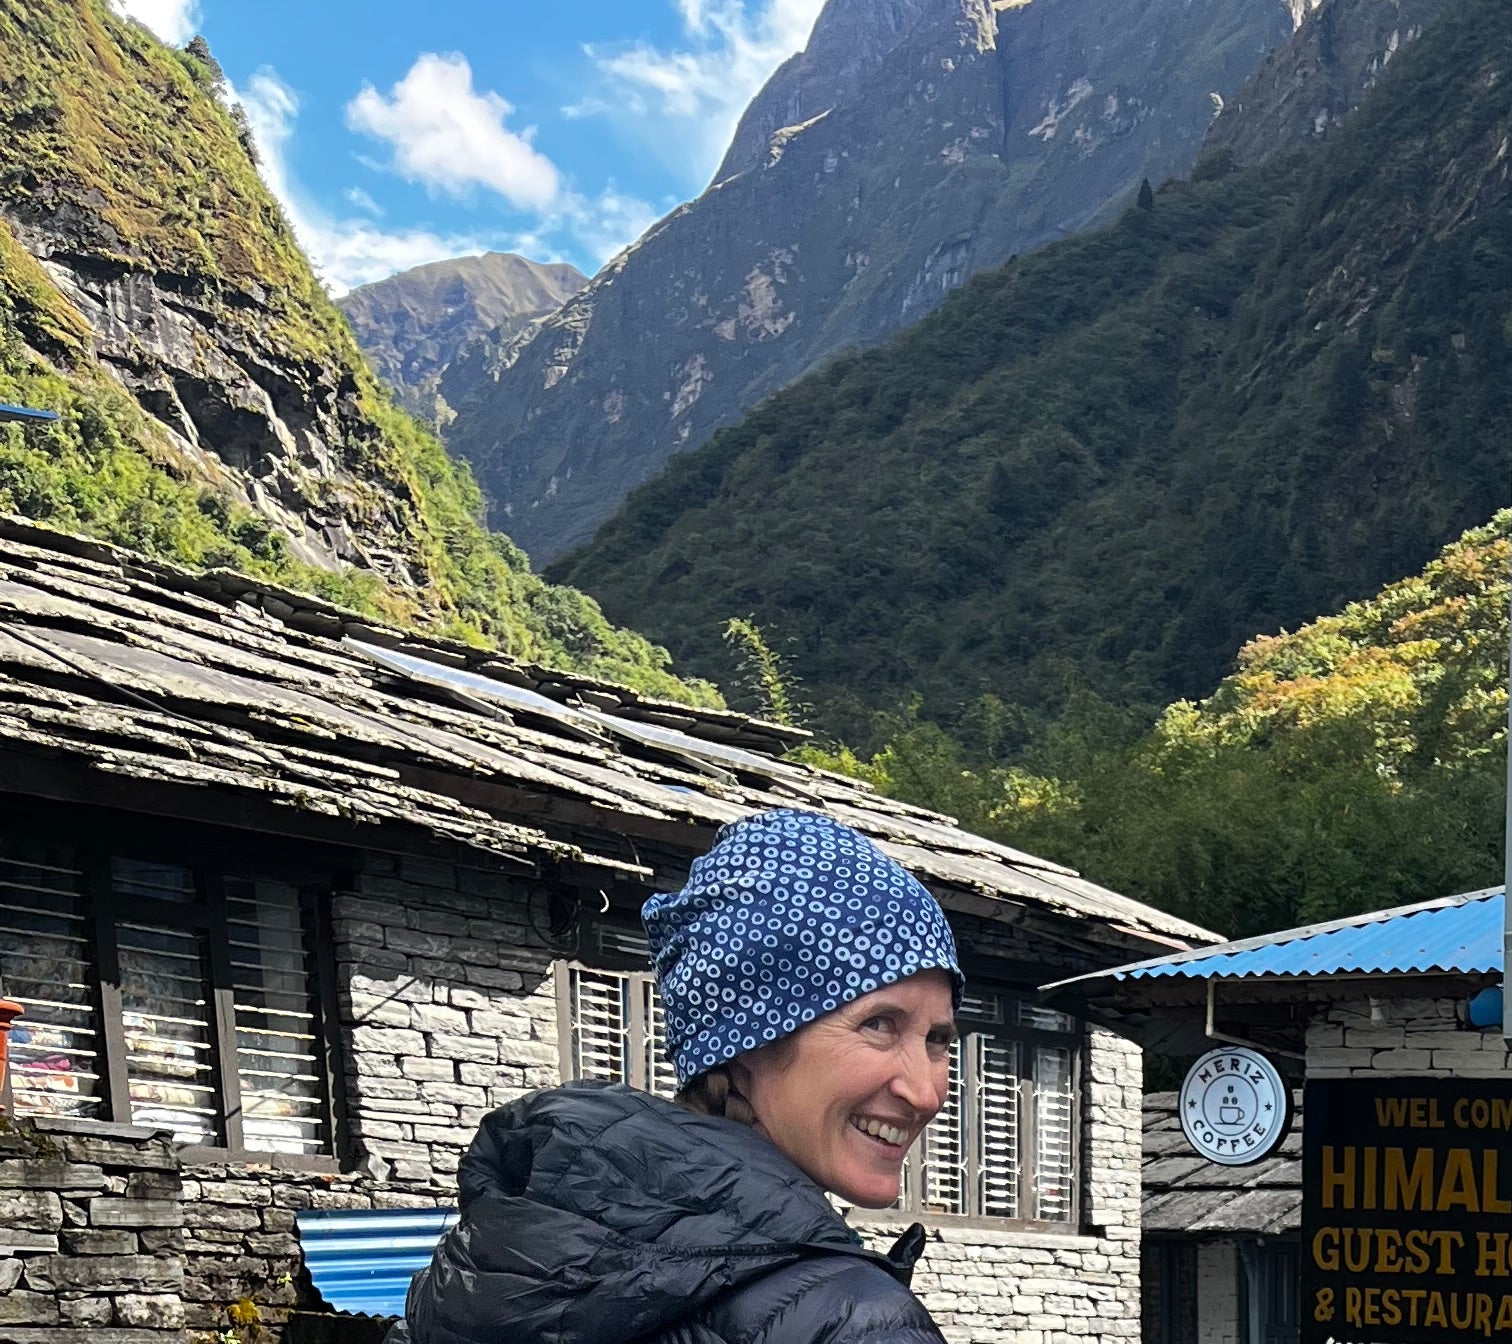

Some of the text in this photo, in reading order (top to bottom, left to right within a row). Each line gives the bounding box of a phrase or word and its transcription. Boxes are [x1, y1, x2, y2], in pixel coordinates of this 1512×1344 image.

[1198, 1058, 1265, 1085] MERIZ
[1375, 1098, 1445, 1128] WEL
[1193, 1120, 1266, 1153] COFFEE
[1312, 1226, 1464, 1275] GUEST
[1313, 1287, 1335, 1323] &
